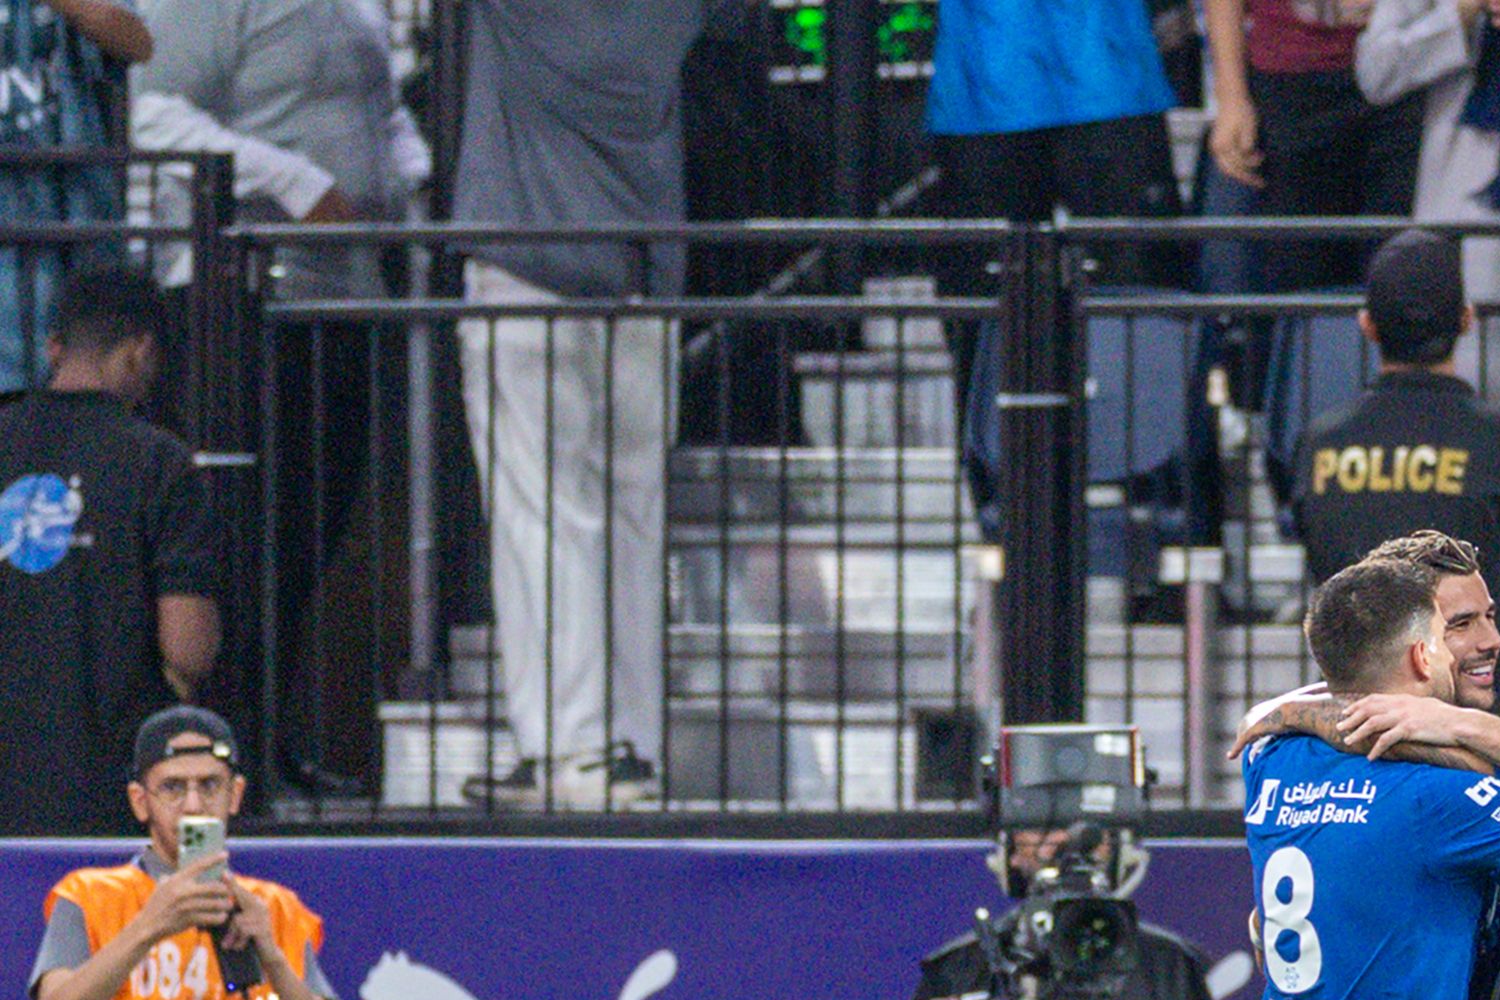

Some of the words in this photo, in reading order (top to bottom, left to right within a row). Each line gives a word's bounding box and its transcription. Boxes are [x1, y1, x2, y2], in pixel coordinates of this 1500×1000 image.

[1313, 444, 1469, 496] POLICE
[1275, 804, 1322, 828] Riyad
[1321, 803, 1369, 825] Bank
[1263, 846, 1322, 994] 8
